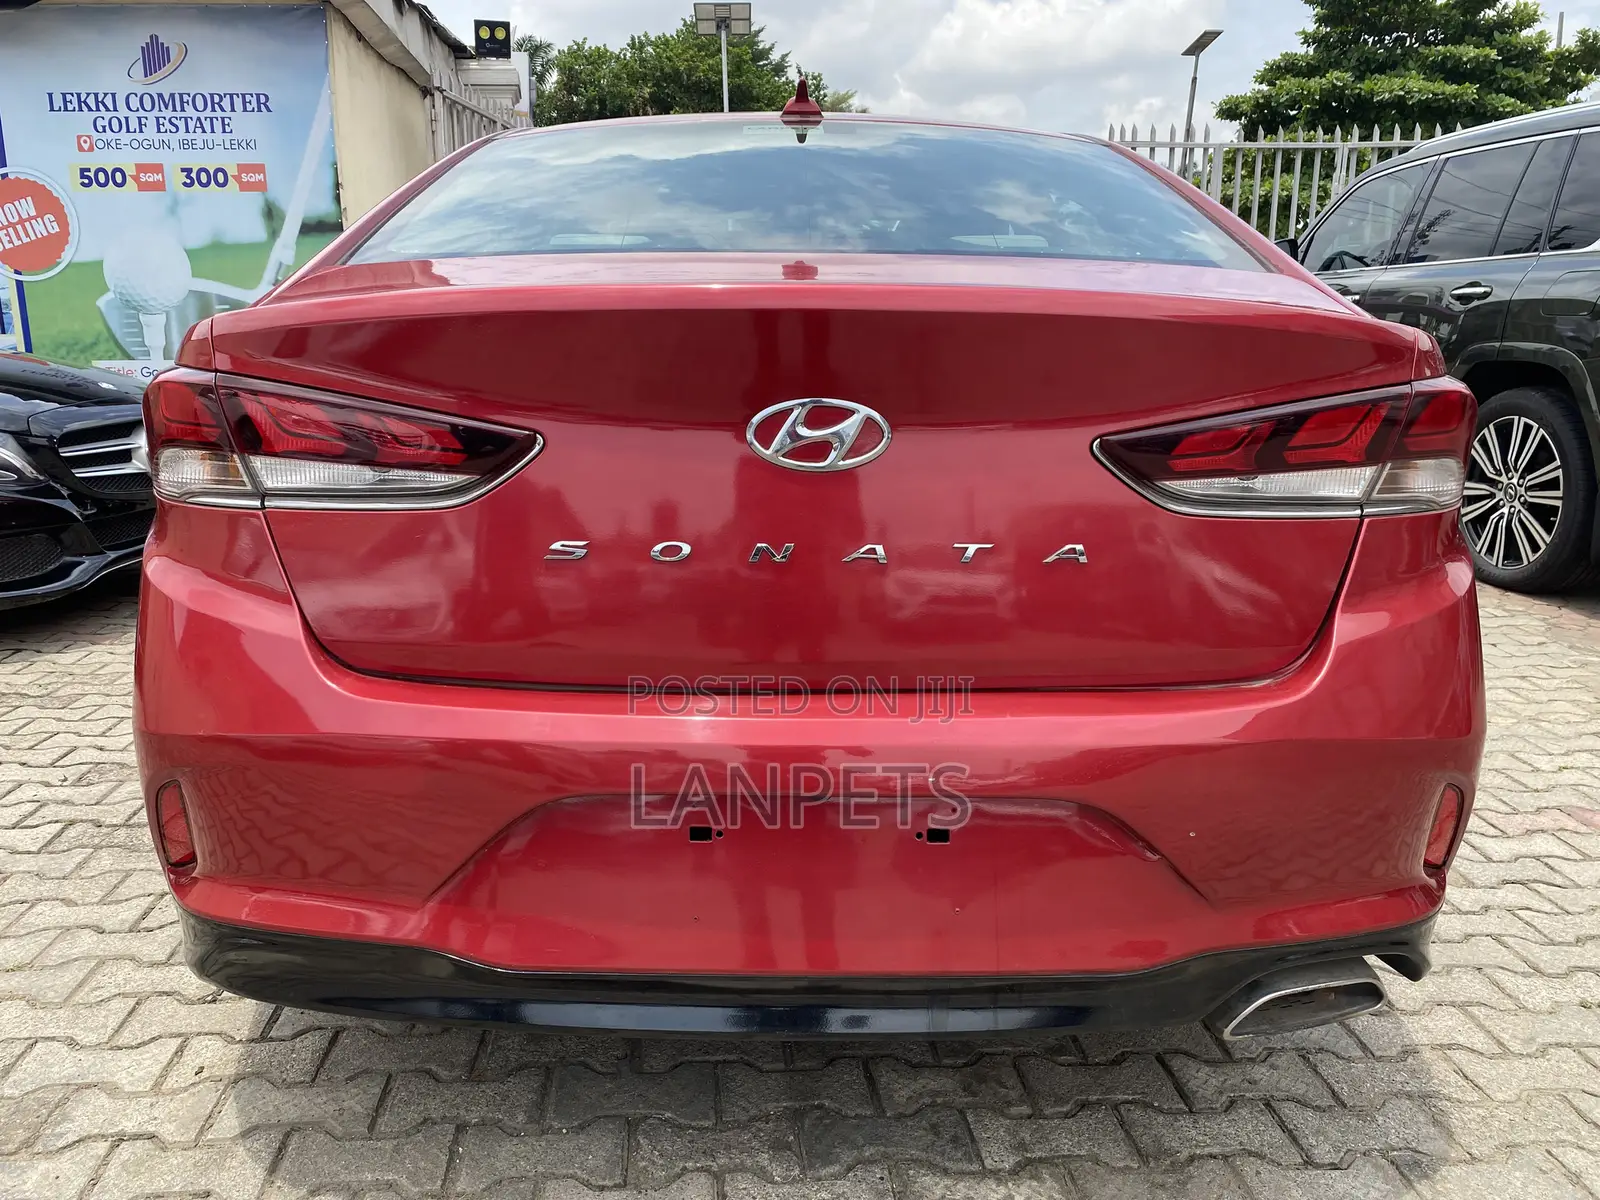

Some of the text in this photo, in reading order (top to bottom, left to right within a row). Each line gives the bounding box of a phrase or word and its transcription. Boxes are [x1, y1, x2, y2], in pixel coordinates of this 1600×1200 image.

[46, 92, 273, 113] LEKKI COMFORTER
[92, 116, 233, 134] GOLF ESTATE
[94, 138, 257, 151] OKE-OGUN, IBEJU-LEKKI
[79, 167, 163, 188] 500 SQM
[180, 167, 264, 188] 300 SQM
[0, 214, 60, 252] ELLING
[544, 541, 1088, 563] SONATA
